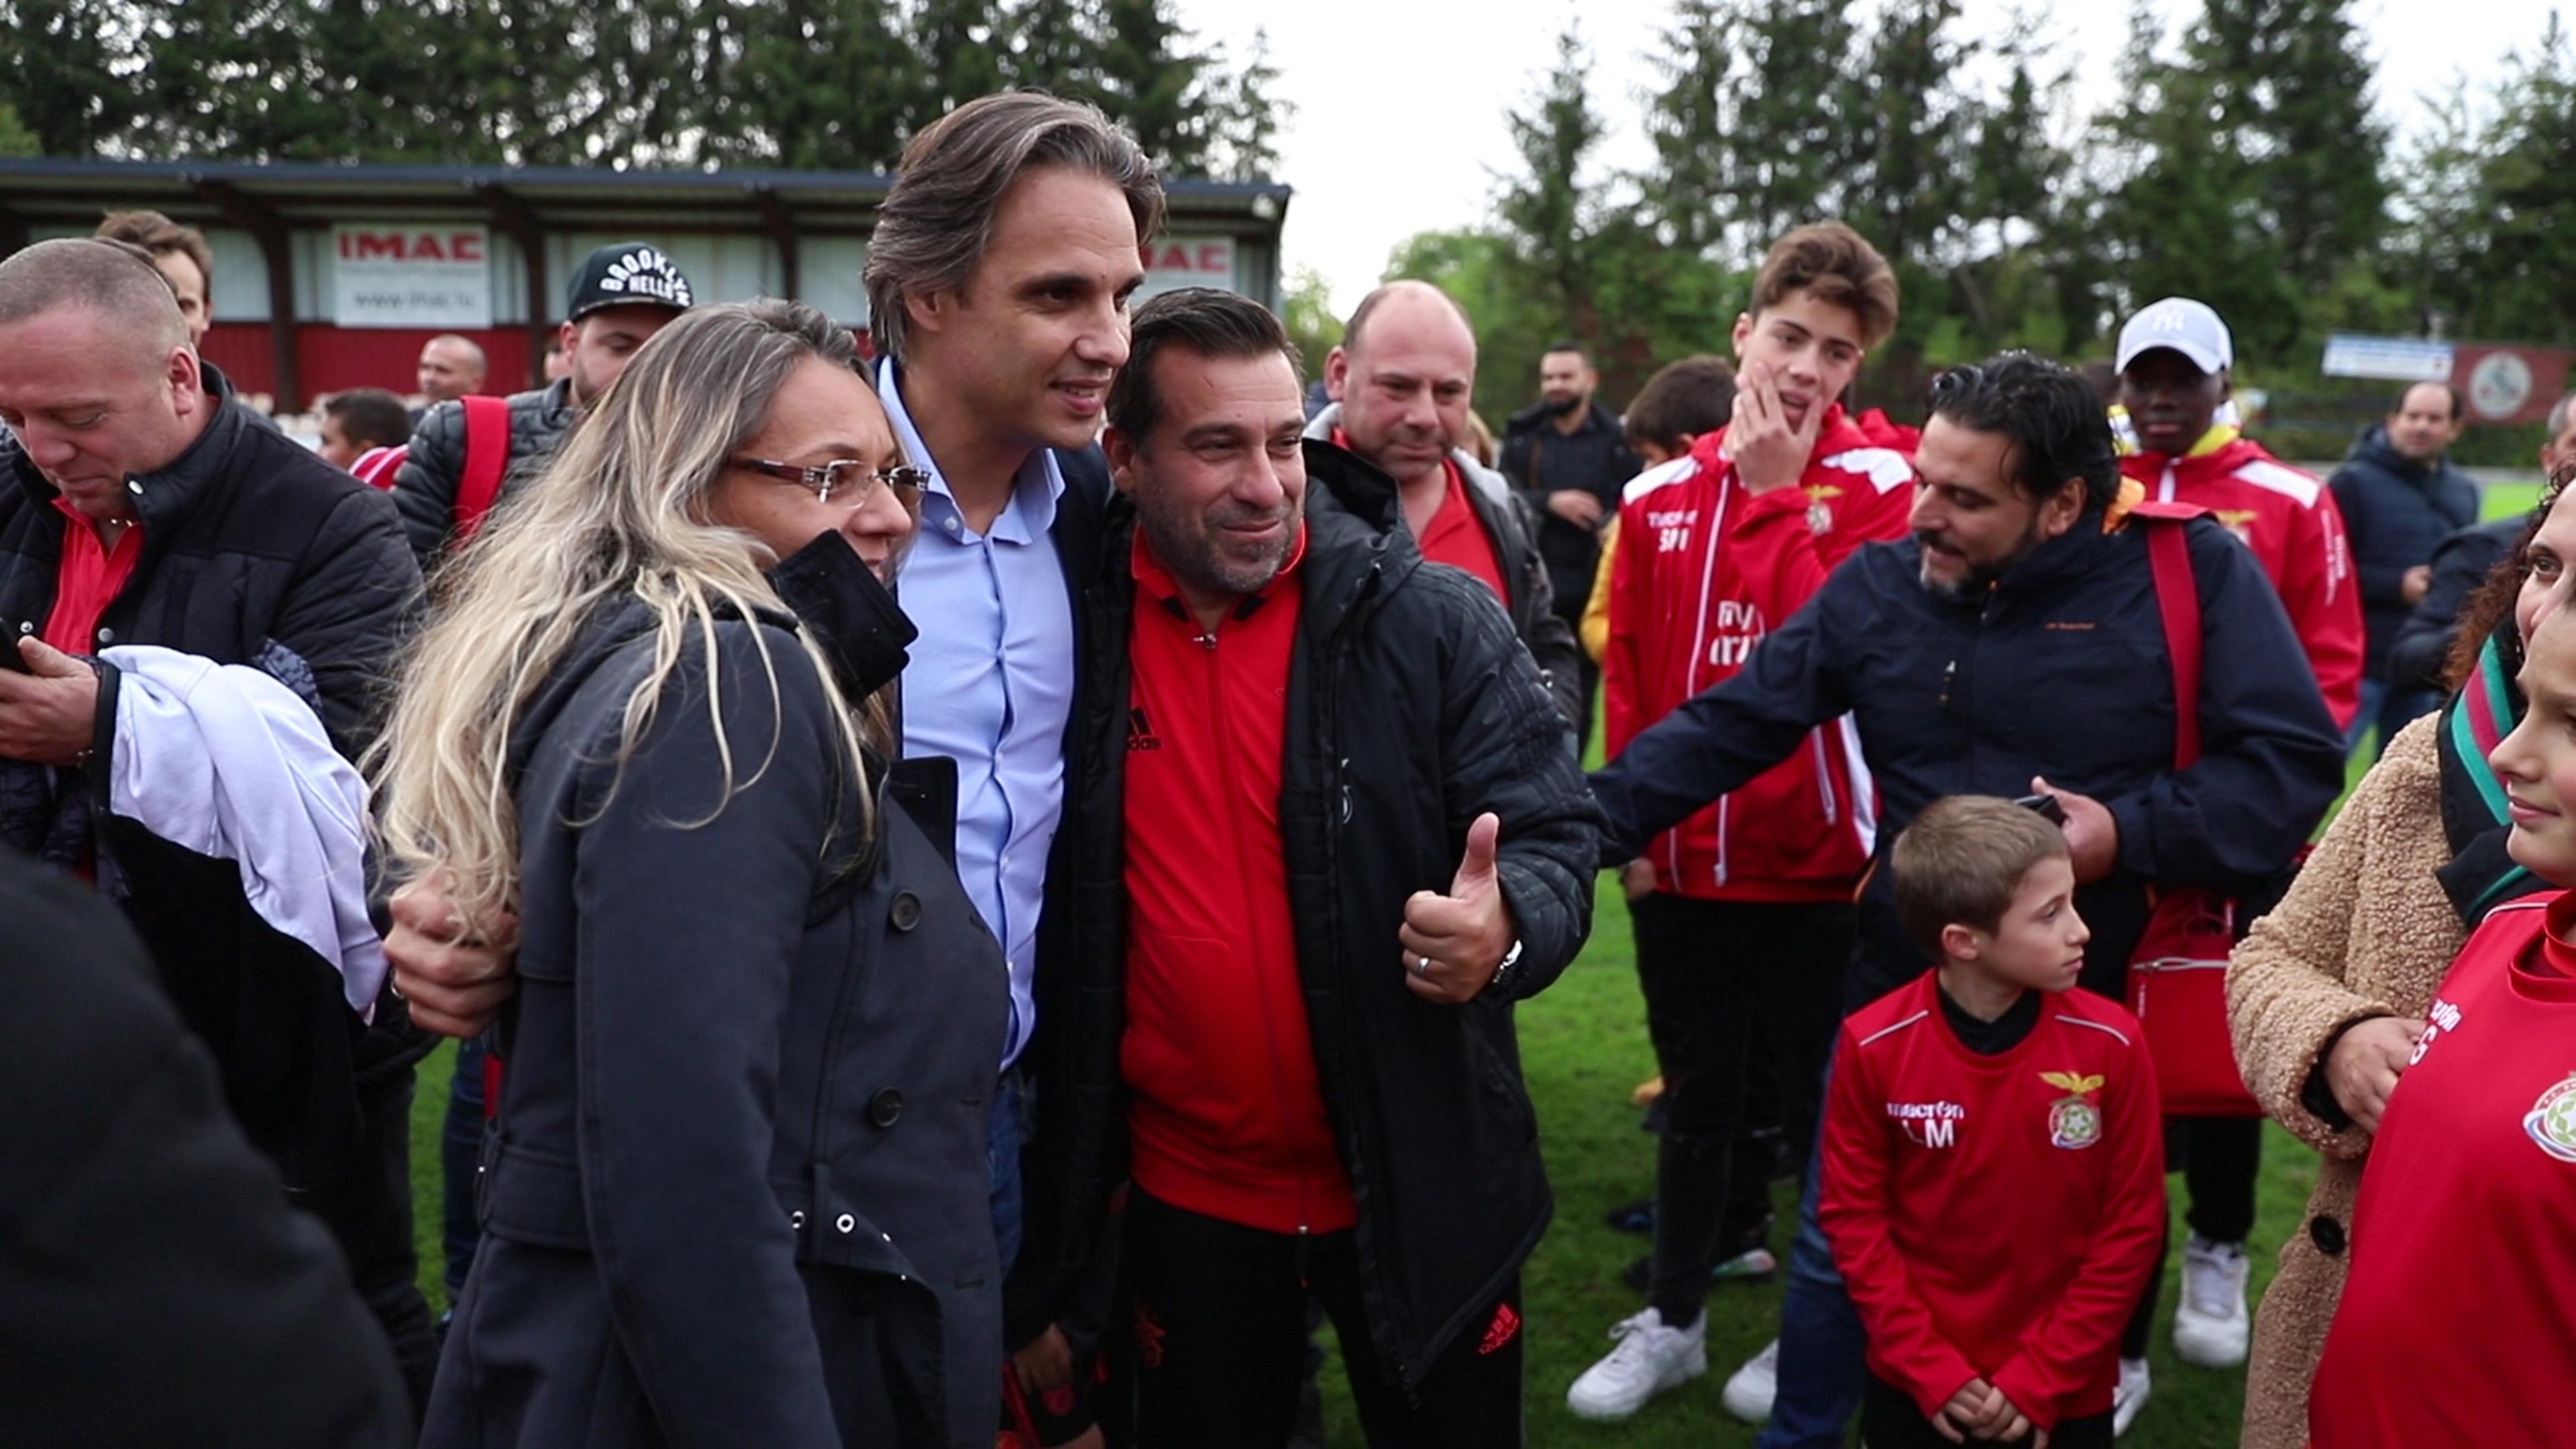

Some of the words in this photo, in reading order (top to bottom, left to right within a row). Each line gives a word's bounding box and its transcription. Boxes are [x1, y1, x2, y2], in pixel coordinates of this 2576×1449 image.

[340, 231, 483, 261] IMAC
[1140, 245, 1227, 273] AC
[600, 248, 690, 307] BROOKLYN
